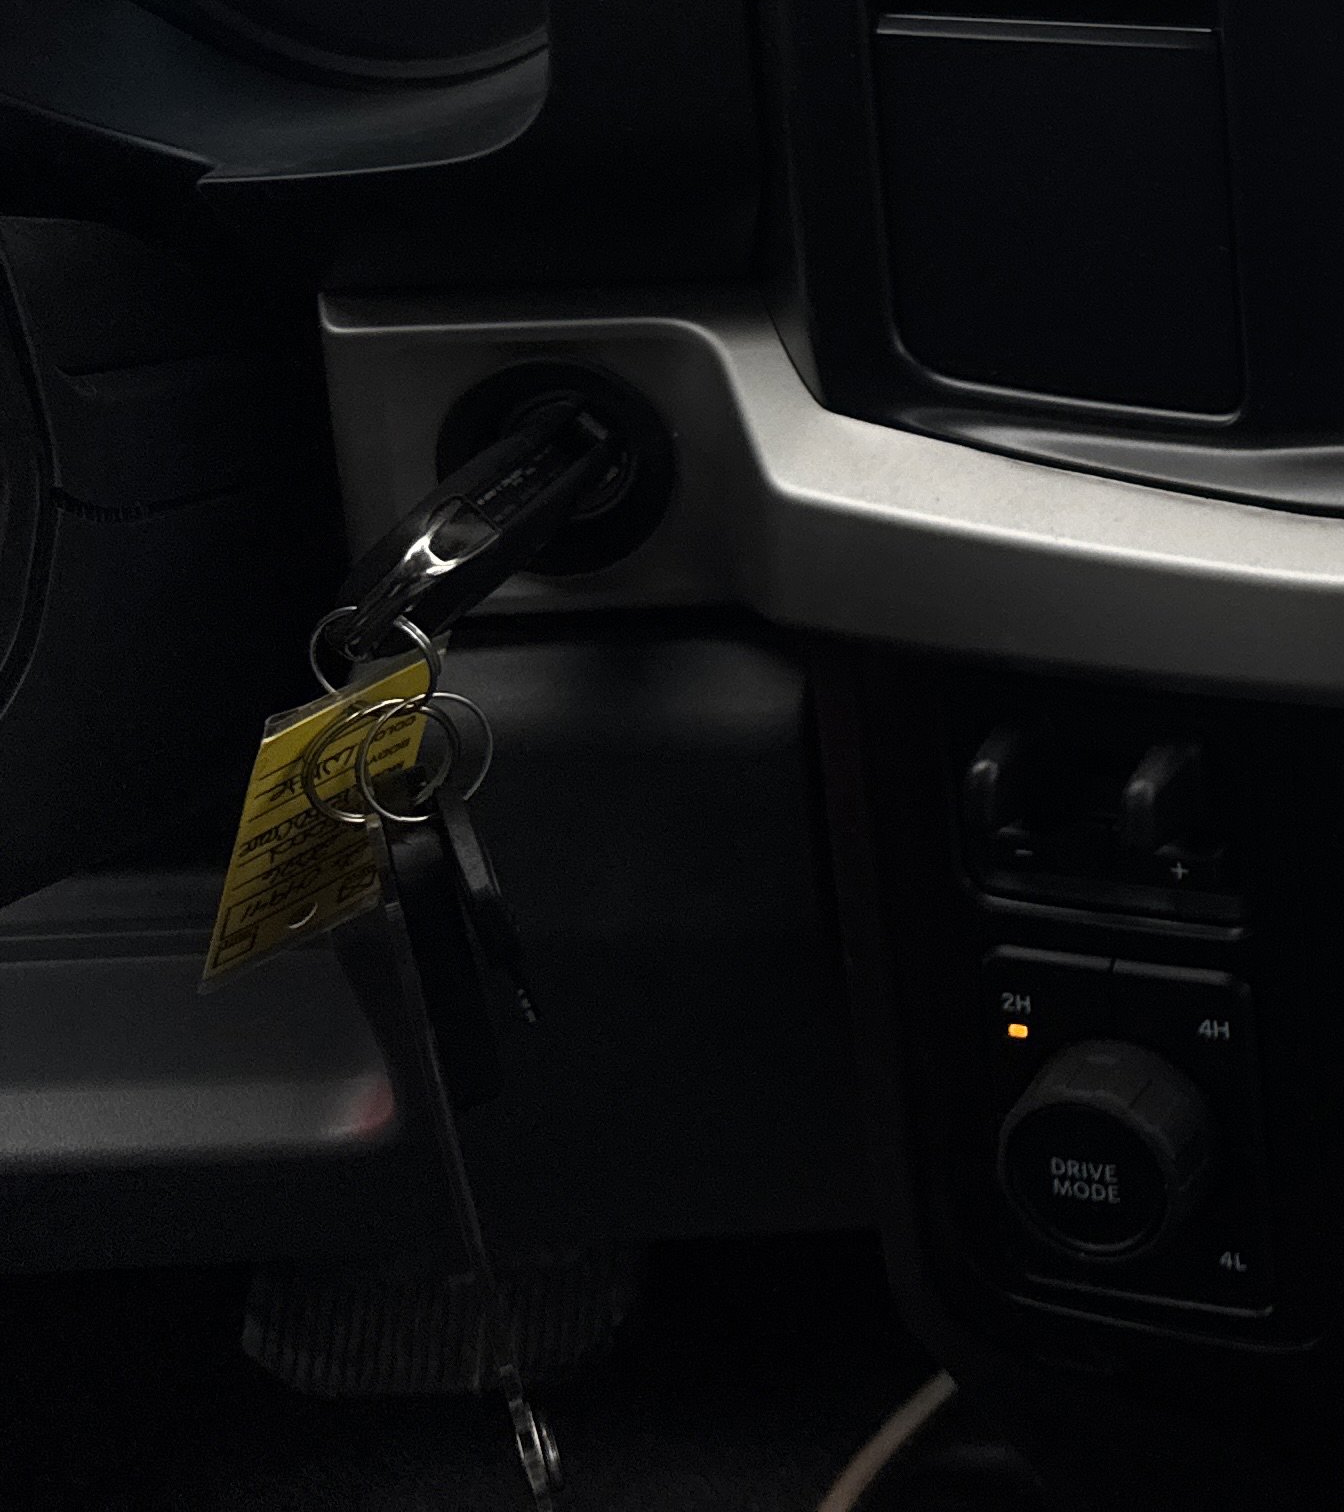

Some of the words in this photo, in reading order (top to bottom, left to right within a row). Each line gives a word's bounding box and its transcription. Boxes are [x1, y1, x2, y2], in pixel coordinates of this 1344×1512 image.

[1002, 993, 1031, 1014] 2H
[1199, 1019, 1231, 1042] 4H
[1051, 1157, 1118, 1183] DRIVE
[1054, 1180, 1120, 1203] MODE
[1219, 1250, 1248, 1273] 4L
